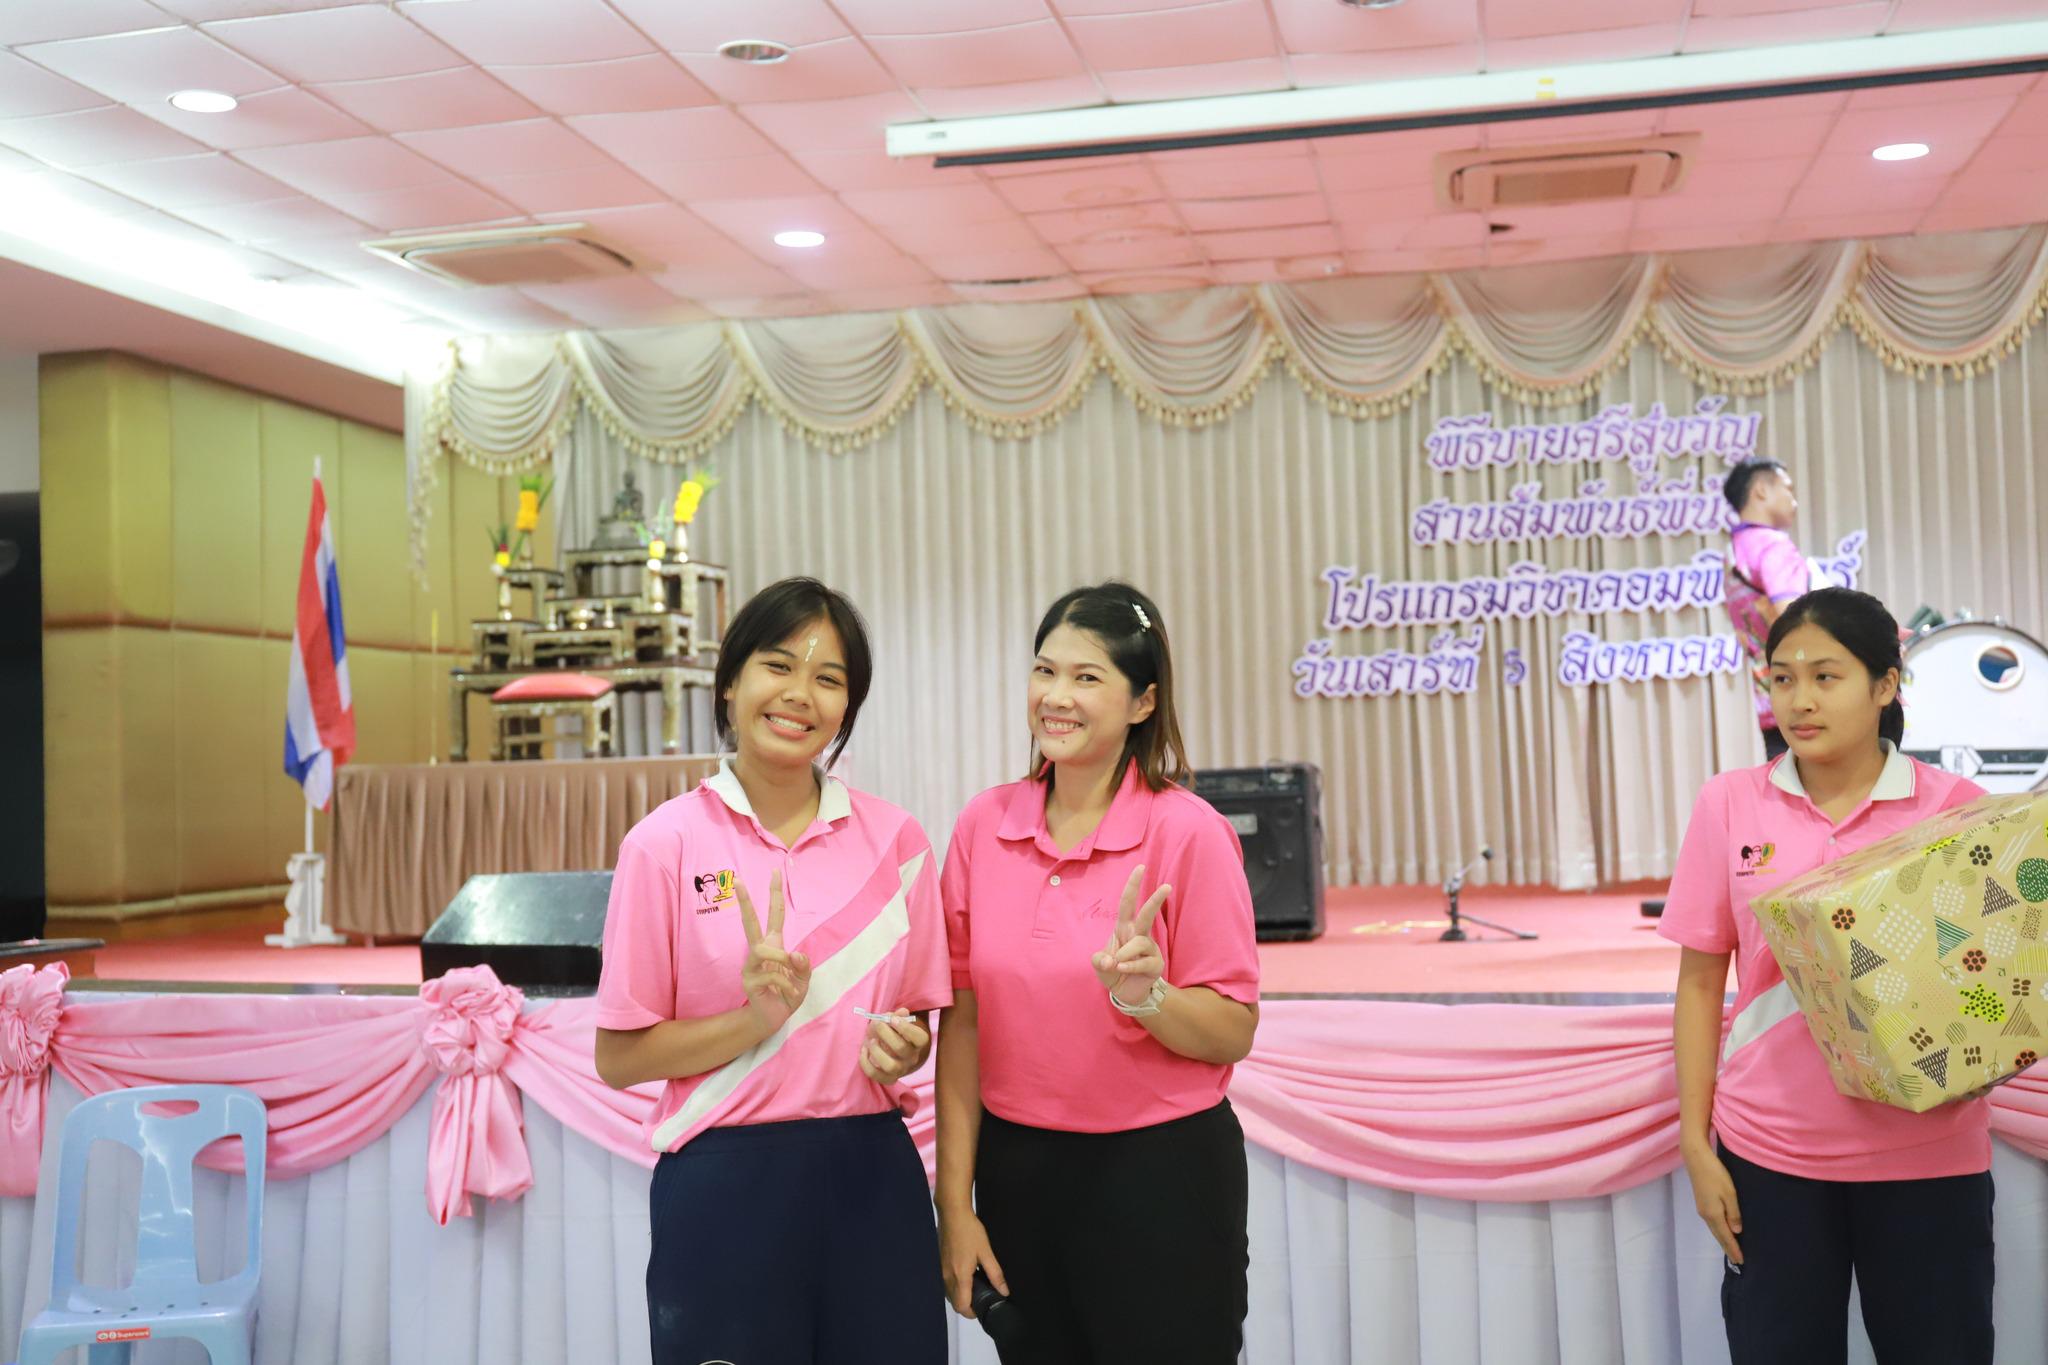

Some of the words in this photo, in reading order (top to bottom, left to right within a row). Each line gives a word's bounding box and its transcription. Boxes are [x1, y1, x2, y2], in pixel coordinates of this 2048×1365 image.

[1428, 398, 1758, 473] พิธีบายศรีสู่ขวัญ
[1413, 469, 1742, 542] สานสัมพันธ์พี่น้
[1295, 626, 1483, 693] วันเสาร์ที่
[1562, 632, 1742, 682] สิงหาคม
